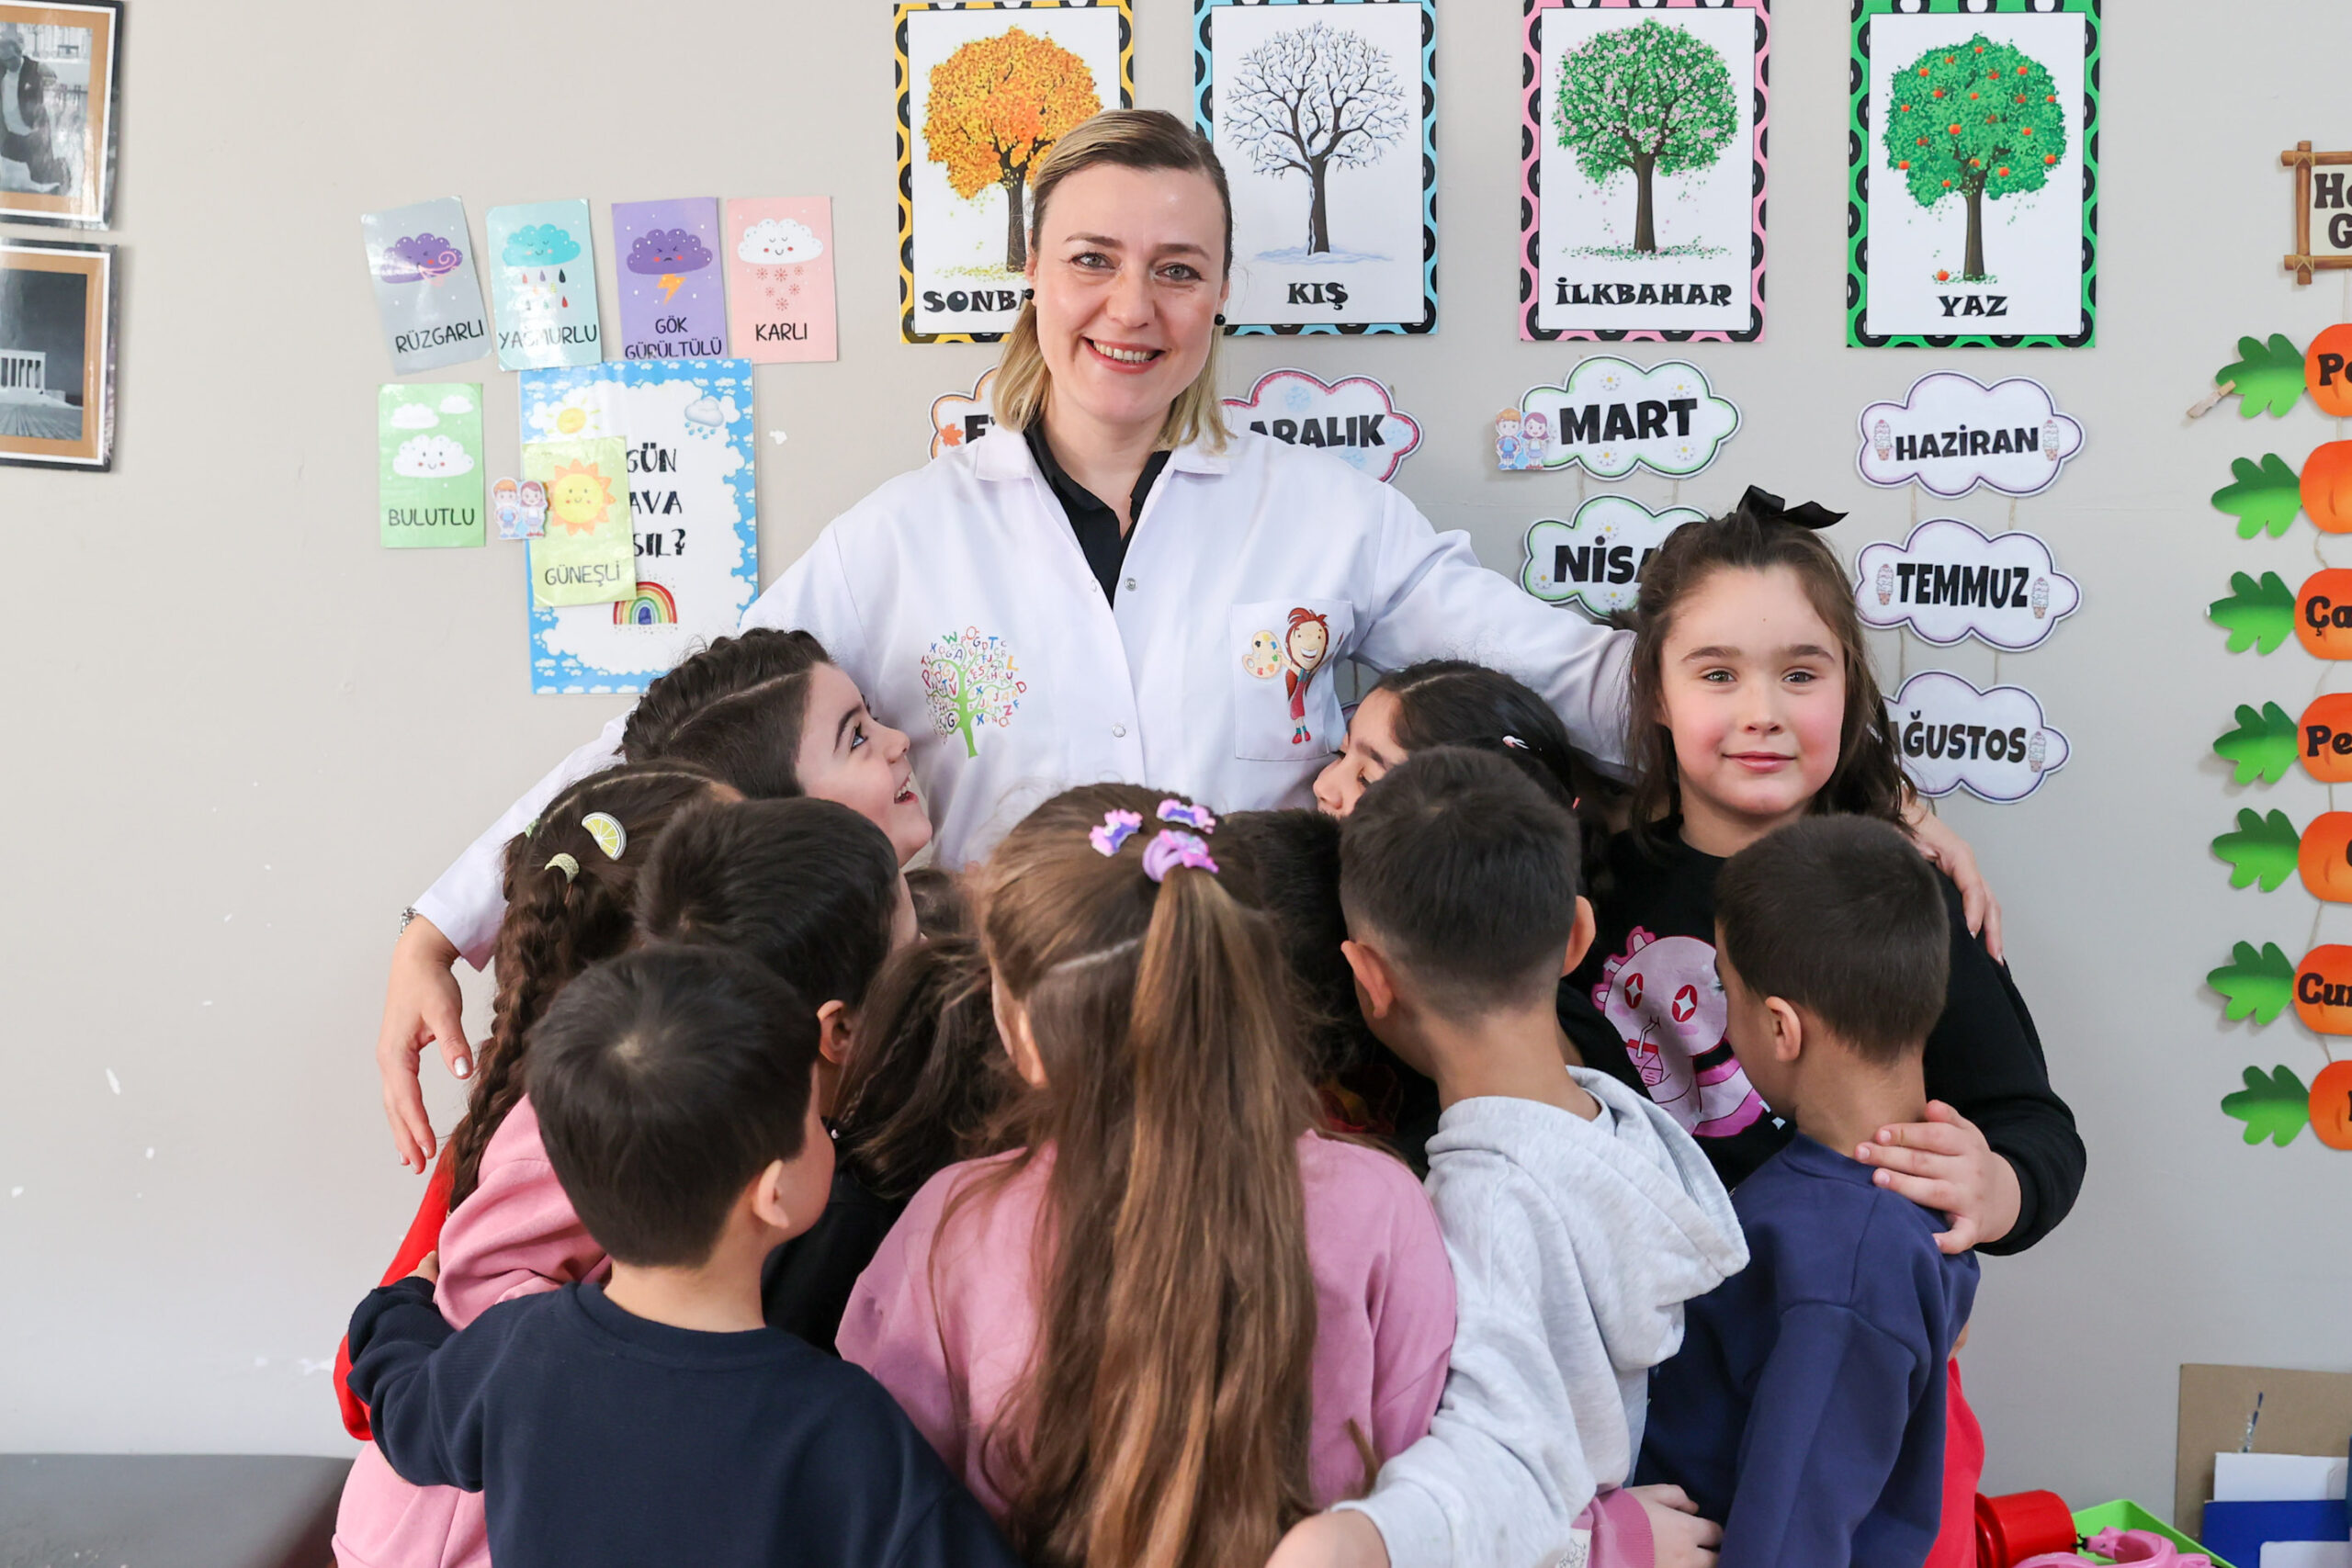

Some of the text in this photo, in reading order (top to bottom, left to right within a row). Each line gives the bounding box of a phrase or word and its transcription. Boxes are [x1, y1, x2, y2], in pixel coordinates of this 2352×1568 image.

[2314, 173, 2352, 209] H
[922, 289, 1025, 312] SONB
[1287, 282, 1349, 310] KIŞ
[1555, 277, 1732, 307] İLKBAHAR
[1939, 295, 2008, 317] YAZ
[395, 319, 485, 354] RÜZGARLI
[655, 315, 688, 334] GÖK
[755, 322, 808, 342] KARLI
[625, 336, 722, 360] GÜRÜLTÜLÜ
[2318, 353, 2352, 386] P
[1560, 399, 1698, 445] MART
[1895, 423, 2039, 461] HAZİRAN
[389, 507, 475, 526] BULUTLU
[545, 564, 621, 586] GÜNEŞLİ
[1896, 564, 2029, 607] TEMMUZ
[2298, 972, 2352, 1008] Cu
